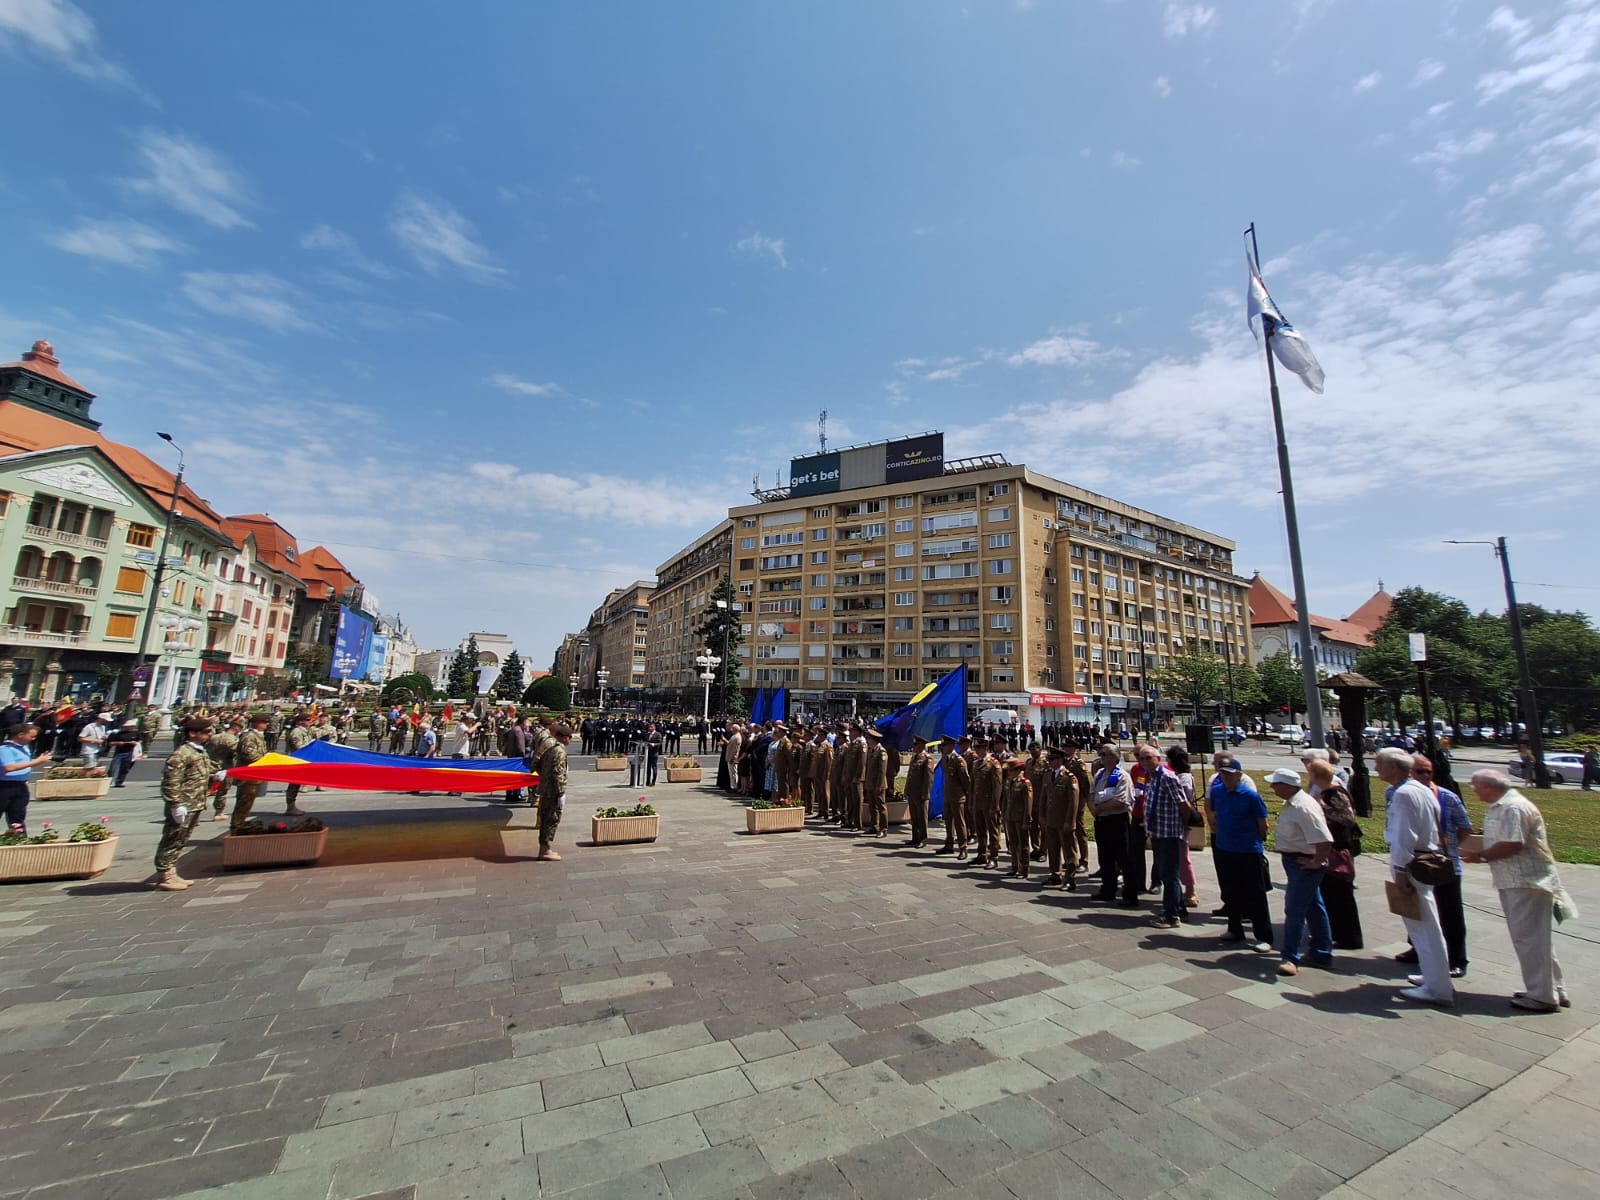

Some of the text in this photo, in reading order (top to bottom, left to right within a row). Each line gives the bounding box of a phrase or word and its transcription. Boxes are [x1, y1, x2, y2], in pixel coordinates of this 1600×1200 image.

[886, 455, 943, 469] CONTICAZINO.RO
[791, 469, 840, 488] get's bet
